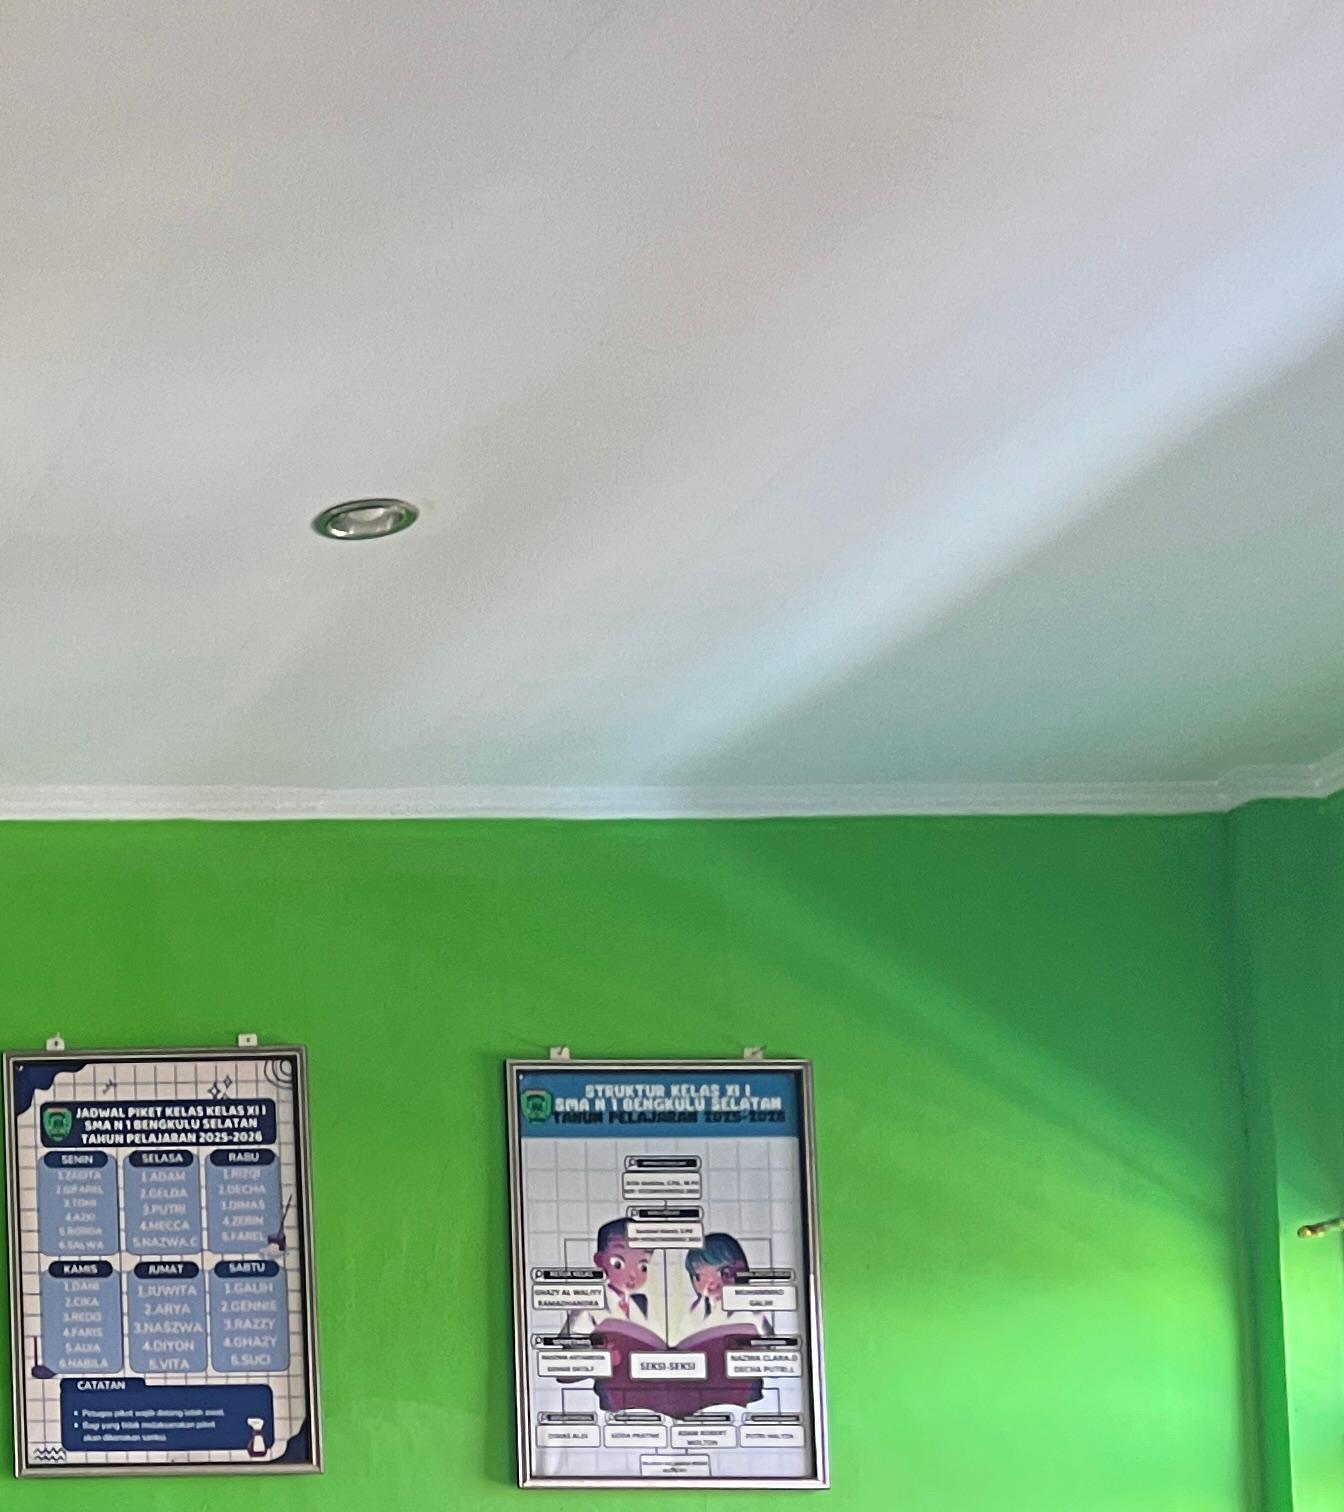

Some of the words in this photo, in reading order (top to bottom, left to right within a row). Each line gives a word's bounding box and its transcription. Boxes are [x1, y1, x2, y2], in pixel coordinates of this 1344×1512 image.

[585, 1084, 665, 1098] STRUKTUR
[671, 1084, 720, 1098] KELAS
[555, 1098, 590, 1112] SMA
[594, 1098, 606, 1112] N
[623, 1098, 705, 1112] BENGKULU
[711, 1097, 782, 1111] SELATAN
[76, 1107, 125, 1118] JADWAL
[128, 1106, 162, 1118] PIKET
[165, 1106, 203, 1117] KELAS
[206, 1106, 244, 1117] KELAS
[246, 1105, 260, 1116] XI
[554, 1111, 604, 1124] TAHUN
[609, 1111, 698, 1124] PELAJARAN
[85, 1120, 112, 1131] SMA
[113, 1120, 124, 1130] N
[133, 1118, 200, 1131] BENGKULU
[202, 1118, 258, 1129] SELATAN
[81, 1132, 124, 1144] TAHUN
[126, 1132, 197, 1144] PELAJARAN
[198, 1131, 263, 1143] 2025-2026
[61, 1154, 94, 1165] SENIN
[141, 1153, 184, 1164] SELASA
[228, 1152, 260, 1163] RABU
[63, 1264, 98, 1275] KAMIS
[148, 1263, 185, 1275] JUMAT
[228, 1262, 267, 1273] SABTU
[76, 1380, 126, 1391] CATATAN
